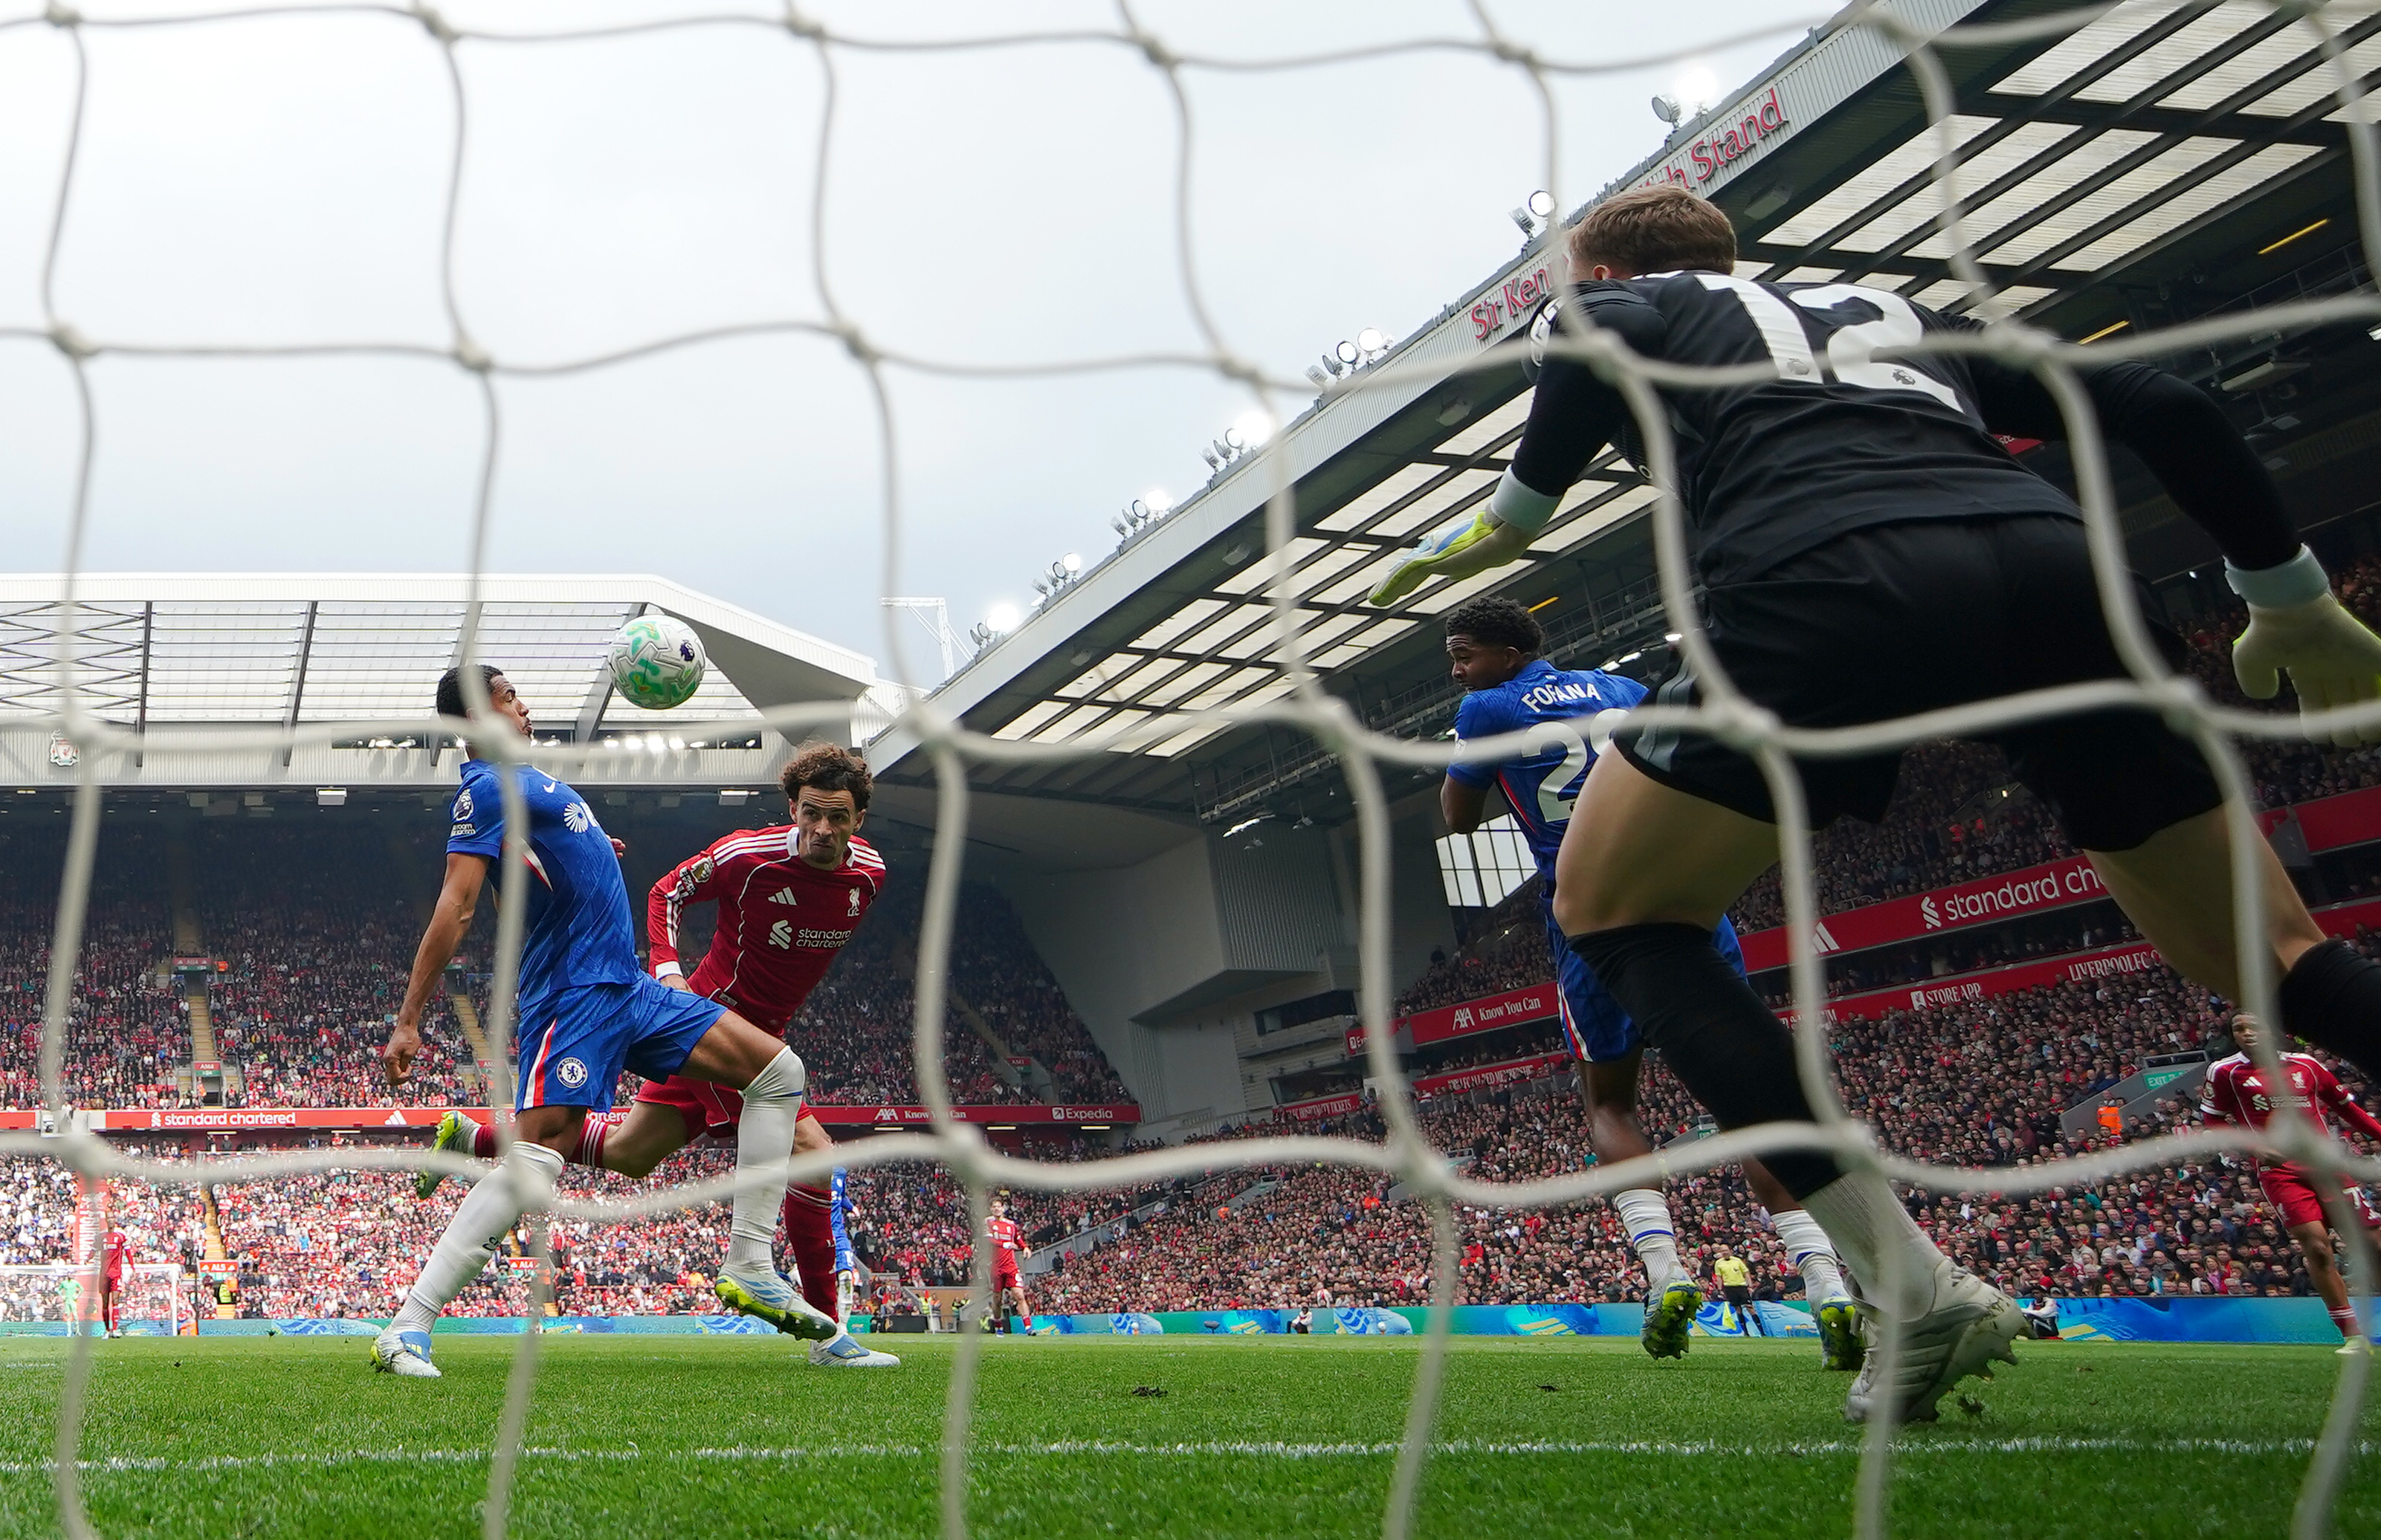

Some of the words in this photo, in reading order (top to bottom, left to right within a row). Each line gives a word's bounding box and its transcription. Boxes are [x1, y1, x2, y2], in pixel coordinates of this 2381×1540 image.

[1691, 88, 1786, 181] Stand
[1470, 300, 1503, 340] Sir
[1502, 260, 1560, 317] Ken
[1694, 274, 1965, 414] 12
[1521, 683, 1601, 713] FOFANA
[1945, 871, 2061, 921] standard
[1926, 986, 1961, 1006] STORE
[1960, 982, 1981, 1000] APP
[1452, 1007, 1476, 1031] AXA
[1479, 1006, 1504, 1021] Know
[1504, 1000, 1522, 1015] You
[1522, 997, 1541, 1011] Can
[2148, 1075, 2167, 1087] EXIT
[164, 1113, 227, 1126] standard
[229, 1112, 296, 1125] chartered
[874, 1108, 899, 1121] AXA
[904, 1110, 930, 1119] Know
[950, 1110, 966, 1119] Can
[1065, 1107, 1114, 1121] Expedia
